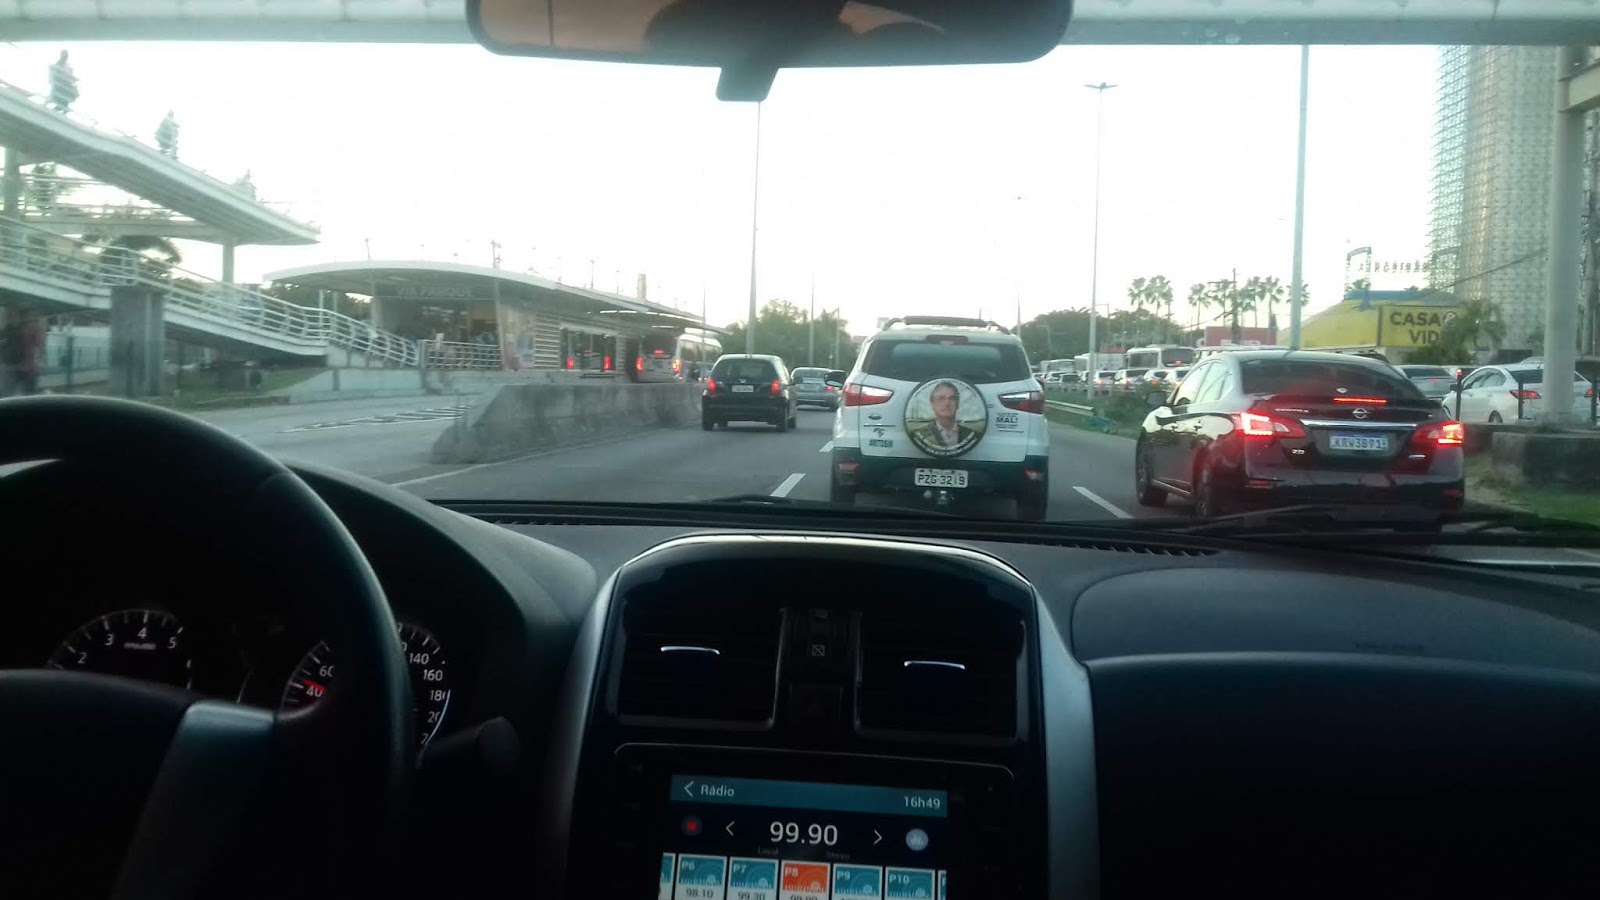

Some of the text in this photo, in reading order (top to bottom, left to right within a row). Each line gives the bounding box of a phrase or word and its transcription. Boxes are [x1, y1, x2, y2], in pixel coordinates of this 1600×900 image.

[1390, 312, 1441, 327] CASA
[1409, 329, 1441, 345] VID
[104, 633, 115, 646] 3
[137, 627, 147, 639] 4
[168, 636, 177, 649] 5
[78, 651, 88, 664] 2
[409, 652, 430, 665] 140
[423, 669, 443, 681] 160
[306, 685, 324, 698] 40
[700, 783, 735, 797] Rádio
[904, 795, 941, 809] 16h49
[769, 820, 838, 846] 99.90
[681, 861, 695, 870] P6
[732, 863, 747, 873] P7
[784, 866, 799, 877] P8
[836, 870, 851, 881] P9
[889, 874, 910, 885] P10
